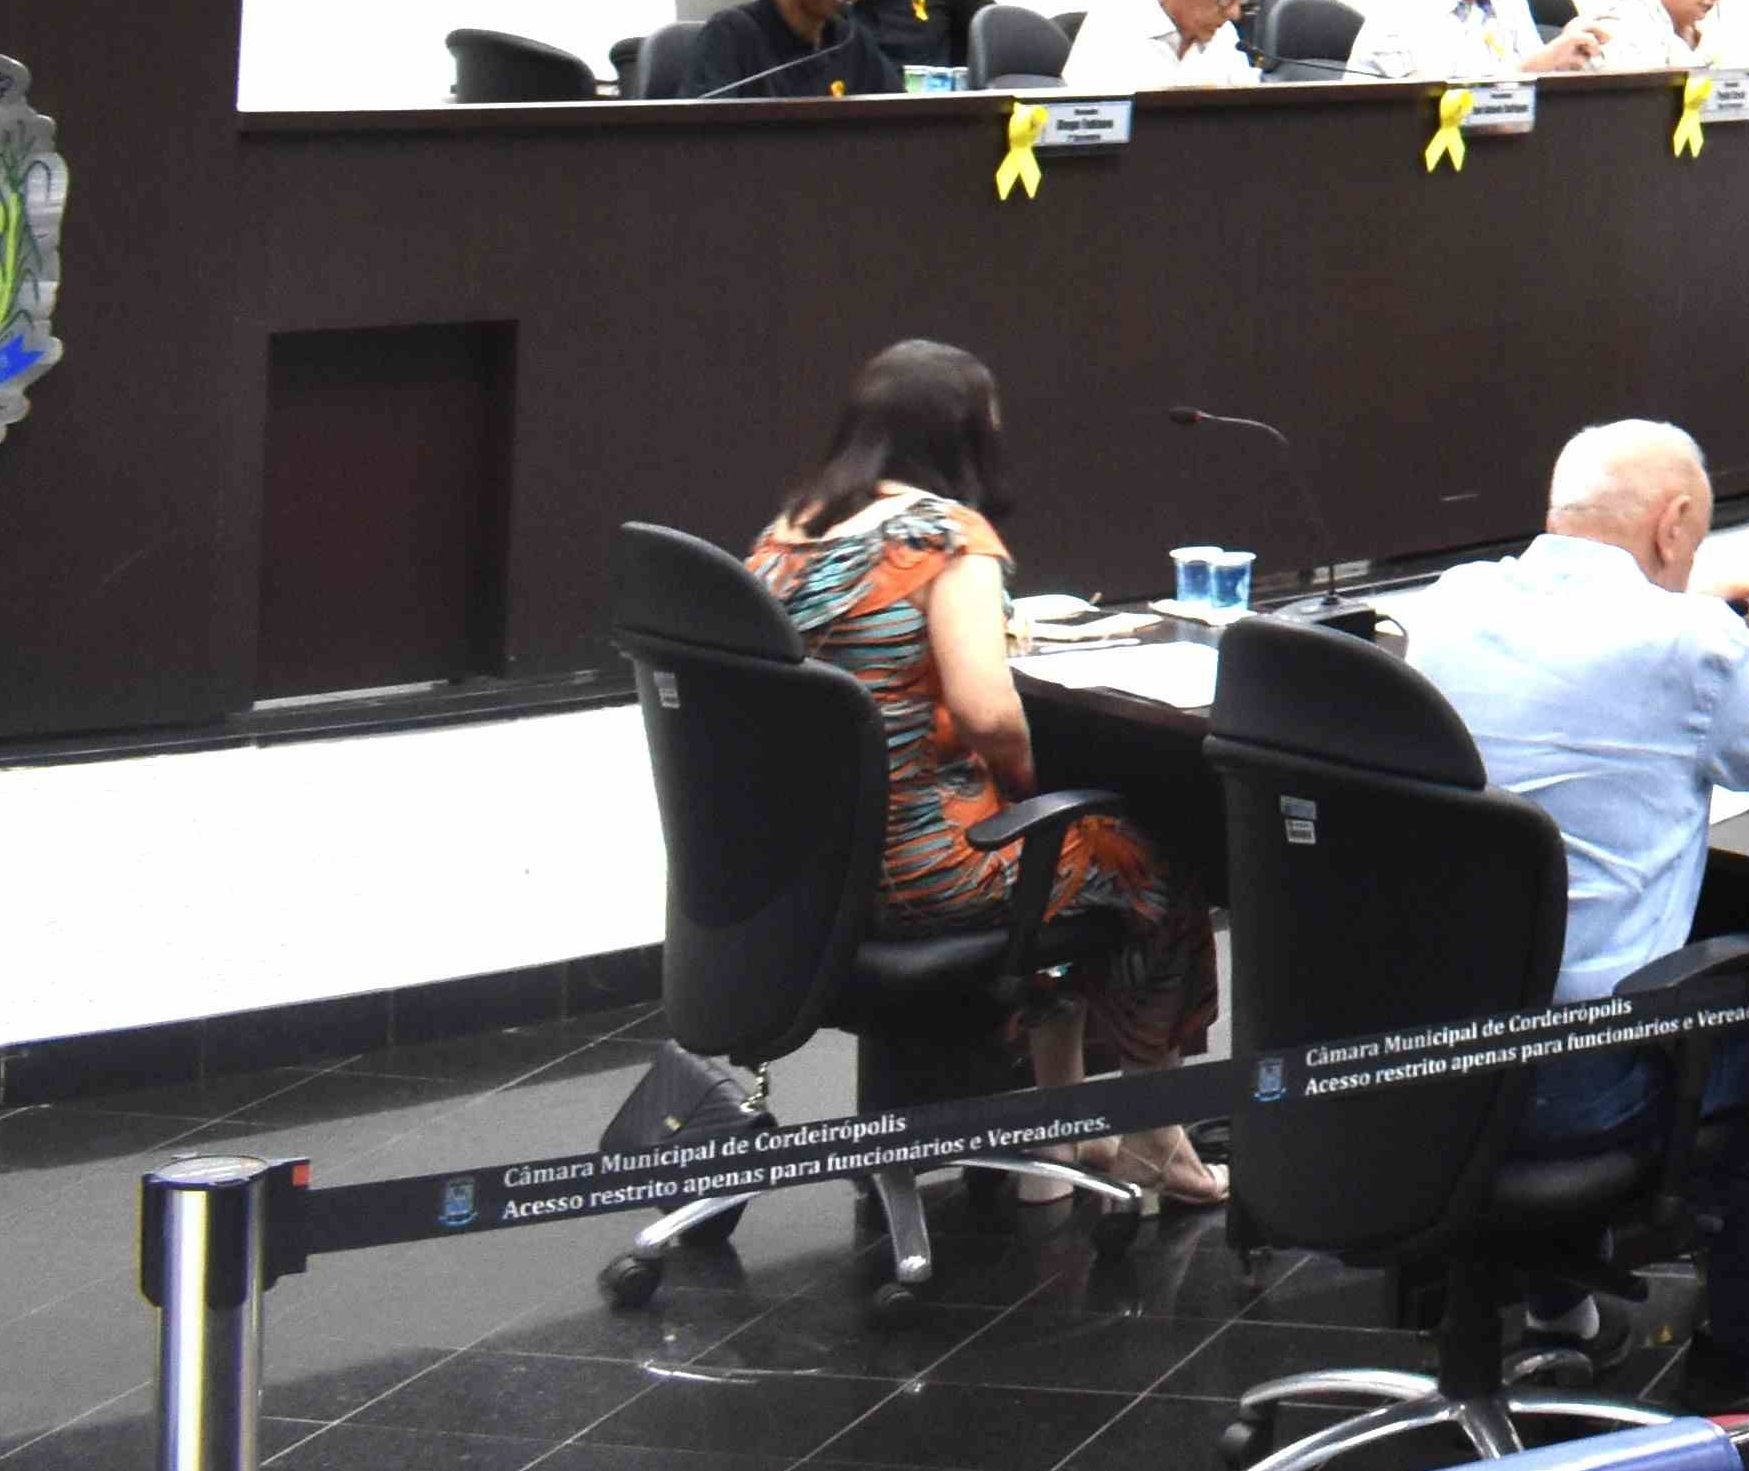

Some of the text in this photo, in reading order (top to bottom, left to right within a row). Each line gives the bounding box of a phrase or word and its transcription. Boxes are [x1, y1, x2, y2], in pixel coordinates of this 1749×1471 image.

[1304, 1070, 1371, 1096] Acesso
[1374, 1057, 1447, 1084] restrito
[1450, 1045, 1518, 1074] apenas
[1521, 1037, 1563, 1063] para
[1567, 1016, 1680, 1052] funcionários
[1682, 1017, 1694, 1030] e
[1305, 997, 1633, 1067] Câmara Municipal de Cordeirópolis
[502, 1114, 1112, 1220] Acesso restrito apenas para funcionários e Vereadores.
[503, 1113, 907, 1188] Câmara Municipal de Cordeirópolis
